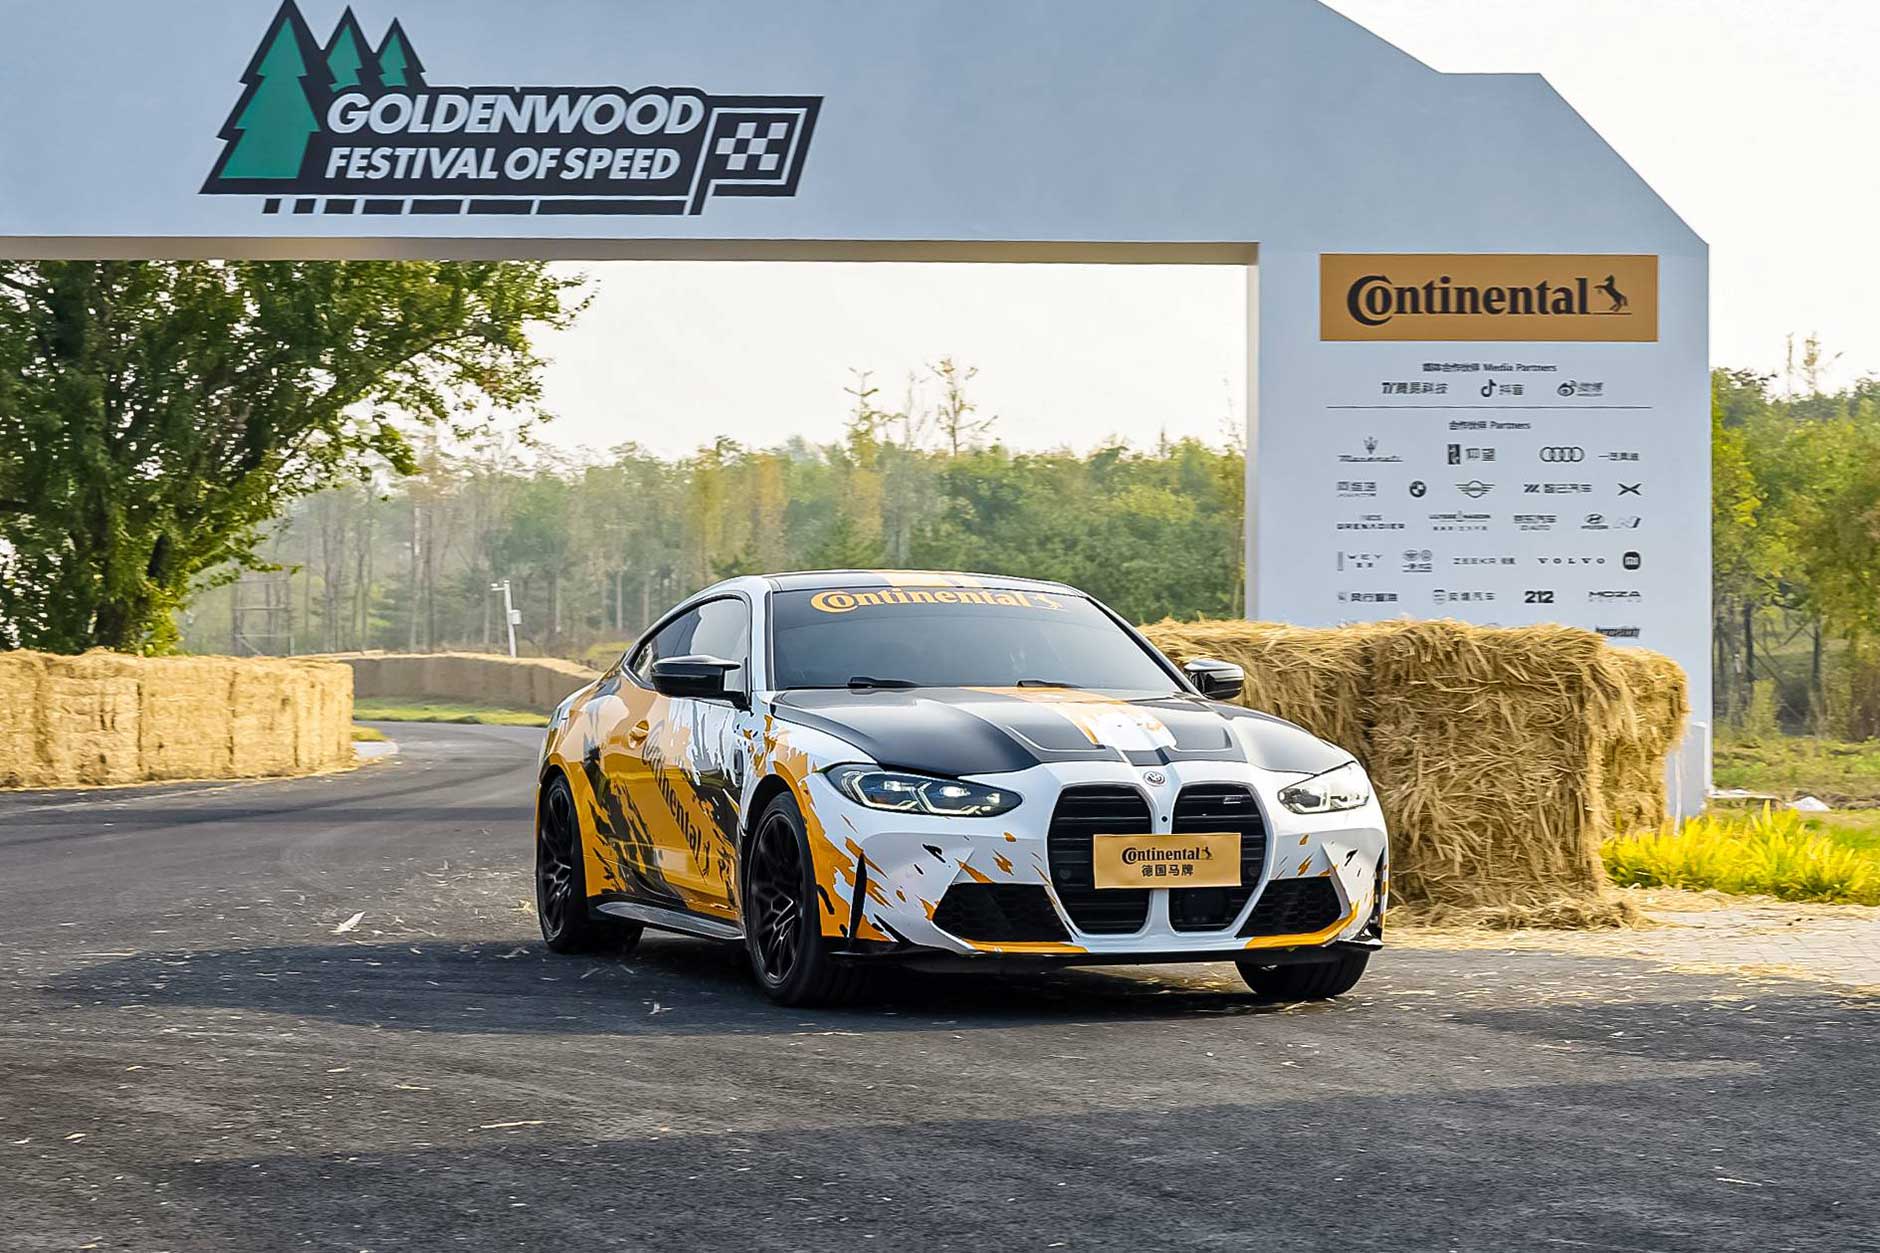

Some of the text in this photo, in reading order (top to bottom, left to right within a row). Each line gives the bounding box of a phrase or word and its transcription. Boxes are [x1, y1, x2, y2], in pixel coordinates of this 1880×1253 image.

[327, 93, 705, 135] GOLDENWOOD
[324, 147, 681, 180] FESTIVAL OF SPEED
[1347, 275, 1591, 326] Continental
[1516, 363, 1557, 372] Partners
[1537, 557, 1605, 565] VOLVO
[811, 588, 1033, 613] Continental
[1524, 590, 1554, 603] 212
[1122, 847, 1200, 864] Continental
[1141, 864, 1194, 877] 德国马牌
